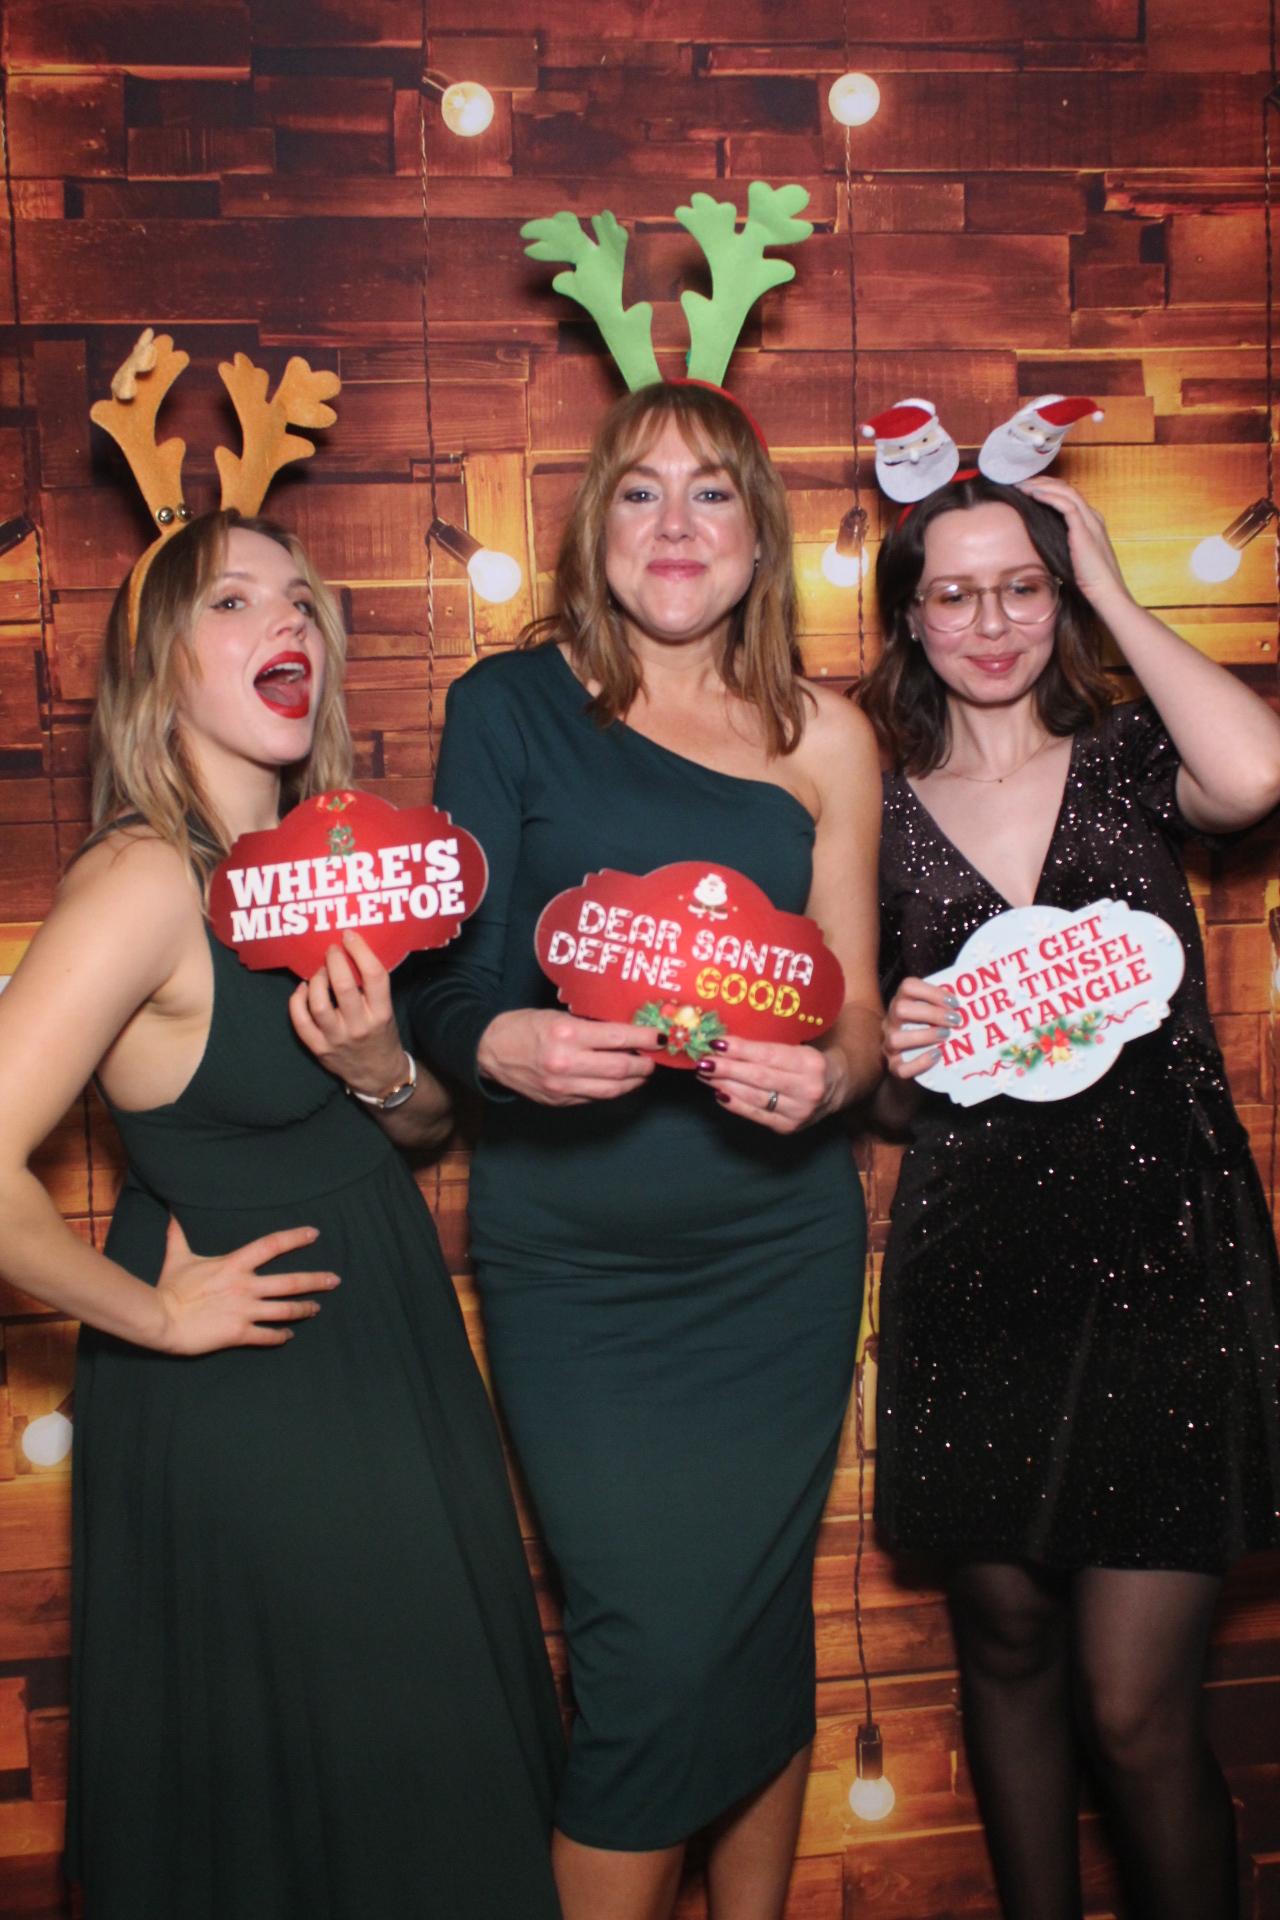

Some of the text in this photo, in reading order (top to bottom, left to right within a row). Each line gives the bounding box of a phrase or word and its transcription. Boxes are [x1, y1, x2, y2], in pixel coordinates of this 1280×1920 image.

[227, 838, 460, 908] WHERE'S
[230, 881, 465, 942] MISTLETOE
[548, 931, 823, 1026] DEFINE GOOD...
[577, 900, 814, 986] DEAR SANTA
[1039, 915, 1102, 961] GET
[938, 958, 1152, 1066] IN A TANGLE
[950, 934, 1143, 1031] OUR TINSEL
